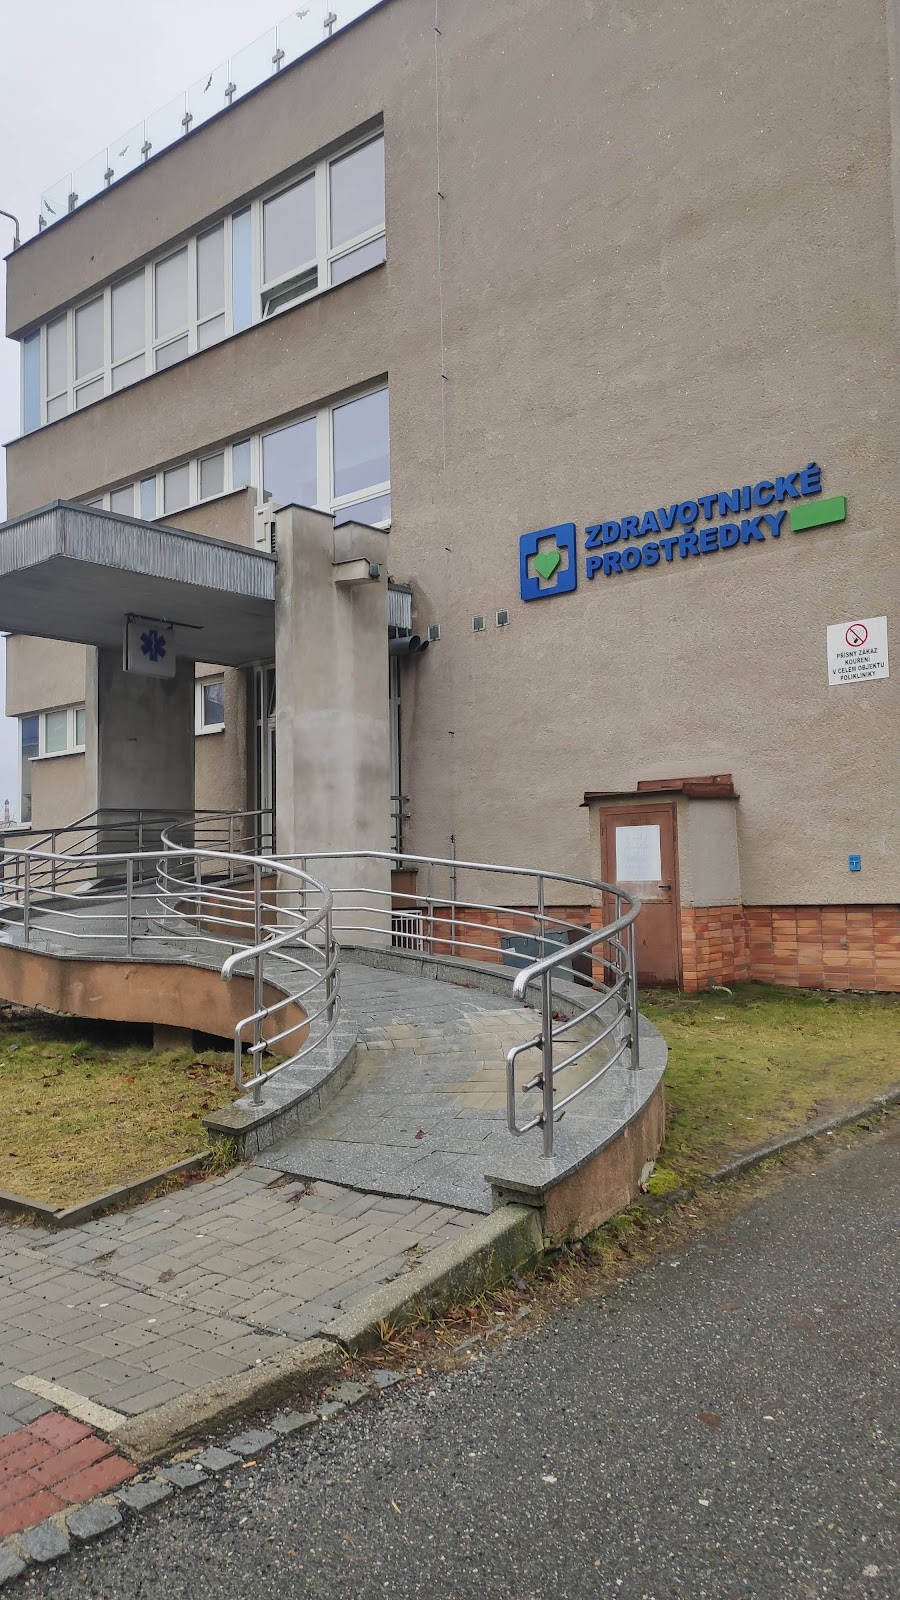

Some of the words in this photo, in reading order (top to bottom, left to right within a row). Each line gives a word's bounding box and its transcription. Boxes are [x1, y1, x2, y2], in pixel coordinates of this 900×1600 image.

[585, 462, 822, 549] ZDRAVOTNICKÉ
[586, 510, 787, 579] PROSTŘEDKY
[840, 671, 876, 681] POLIKLINIKY
[858, 662, 885, 671] OBJEKTU
